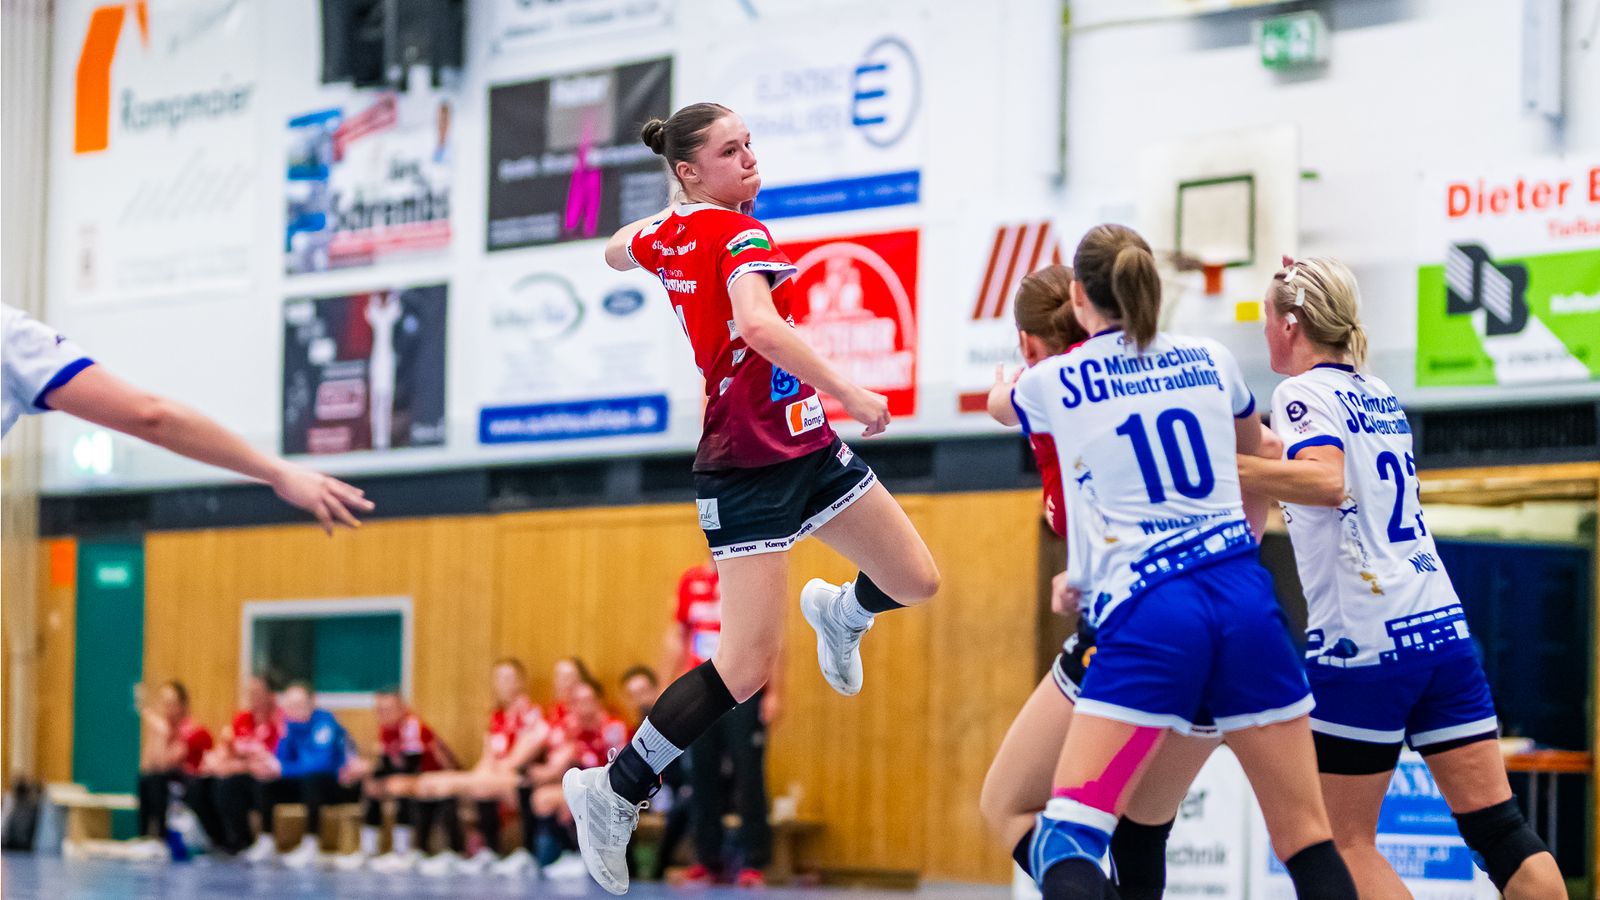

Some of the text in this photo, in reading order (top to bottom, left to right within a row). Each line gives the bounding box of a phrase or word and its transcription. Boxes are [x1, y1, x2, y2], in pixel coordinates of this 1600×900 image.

[1447, 177, 1570, 218] Dieter
[1060, 358, 1110, 409] SG
[1109, 364, 1225, 398] Neutraubling
[1115, 407, 1216, 505] 10
[831, 492, 855, 511] Kempa
[730, 543, 757, 554] Kempa
